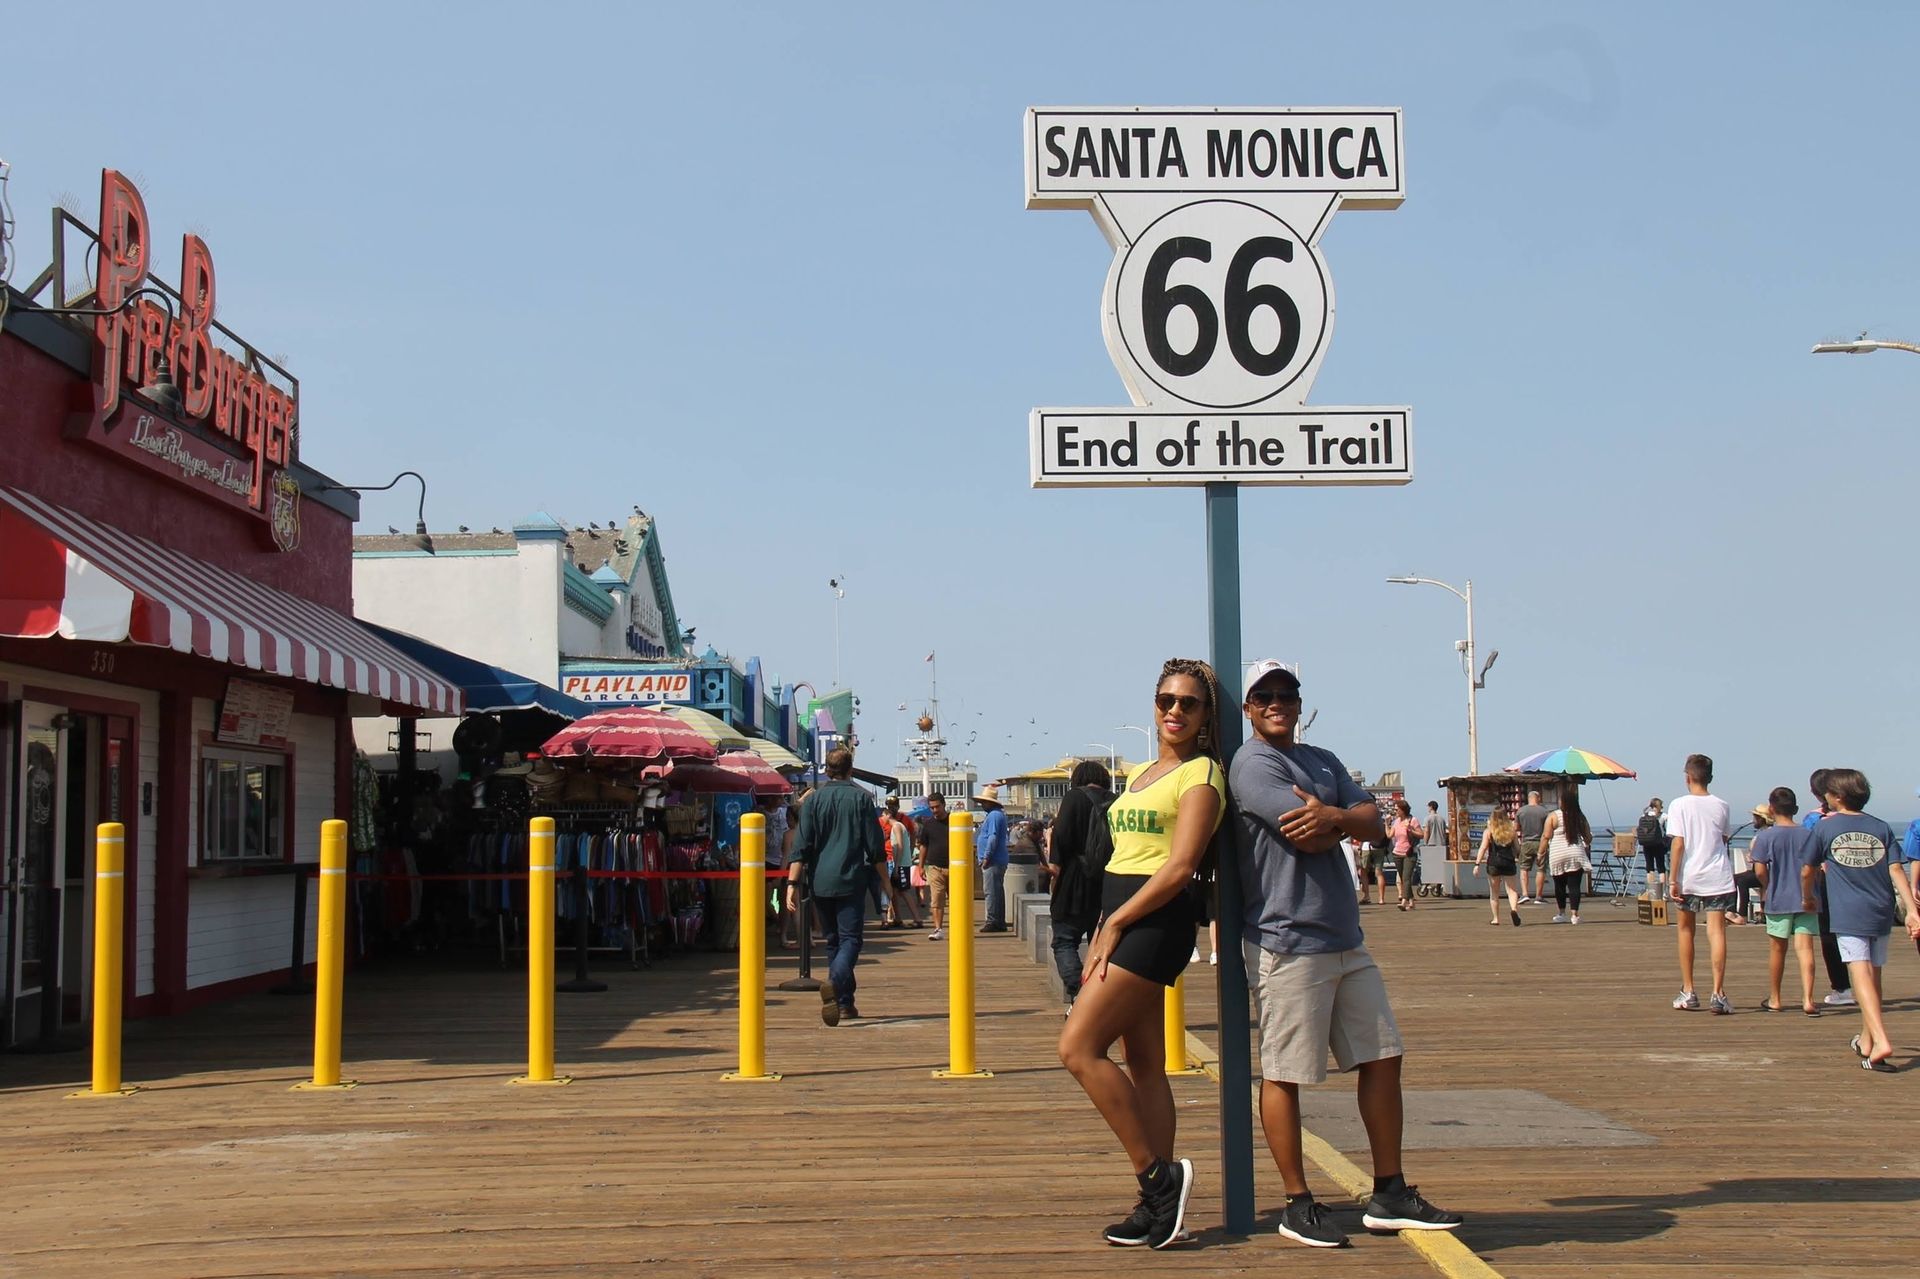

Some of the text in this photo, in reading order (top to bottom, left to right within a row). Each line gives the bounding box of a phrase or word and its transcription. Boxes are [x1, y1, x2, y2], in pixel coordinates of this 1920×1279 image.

[1045, 126, 1388, 180] SANTA MONICA
[1141, 235, 1301, 378] 66
[97, 168, 293, 511] Pier Burger
[1057, 419, 1393, 467] End of the Trail
[91, 651, 115, 673] 330
[565, 676, 689, 693] PLAYLAND
[584, 693, 670, 701] ARCADE
[1834, 832, 1879, 847] SAN DIEGO
